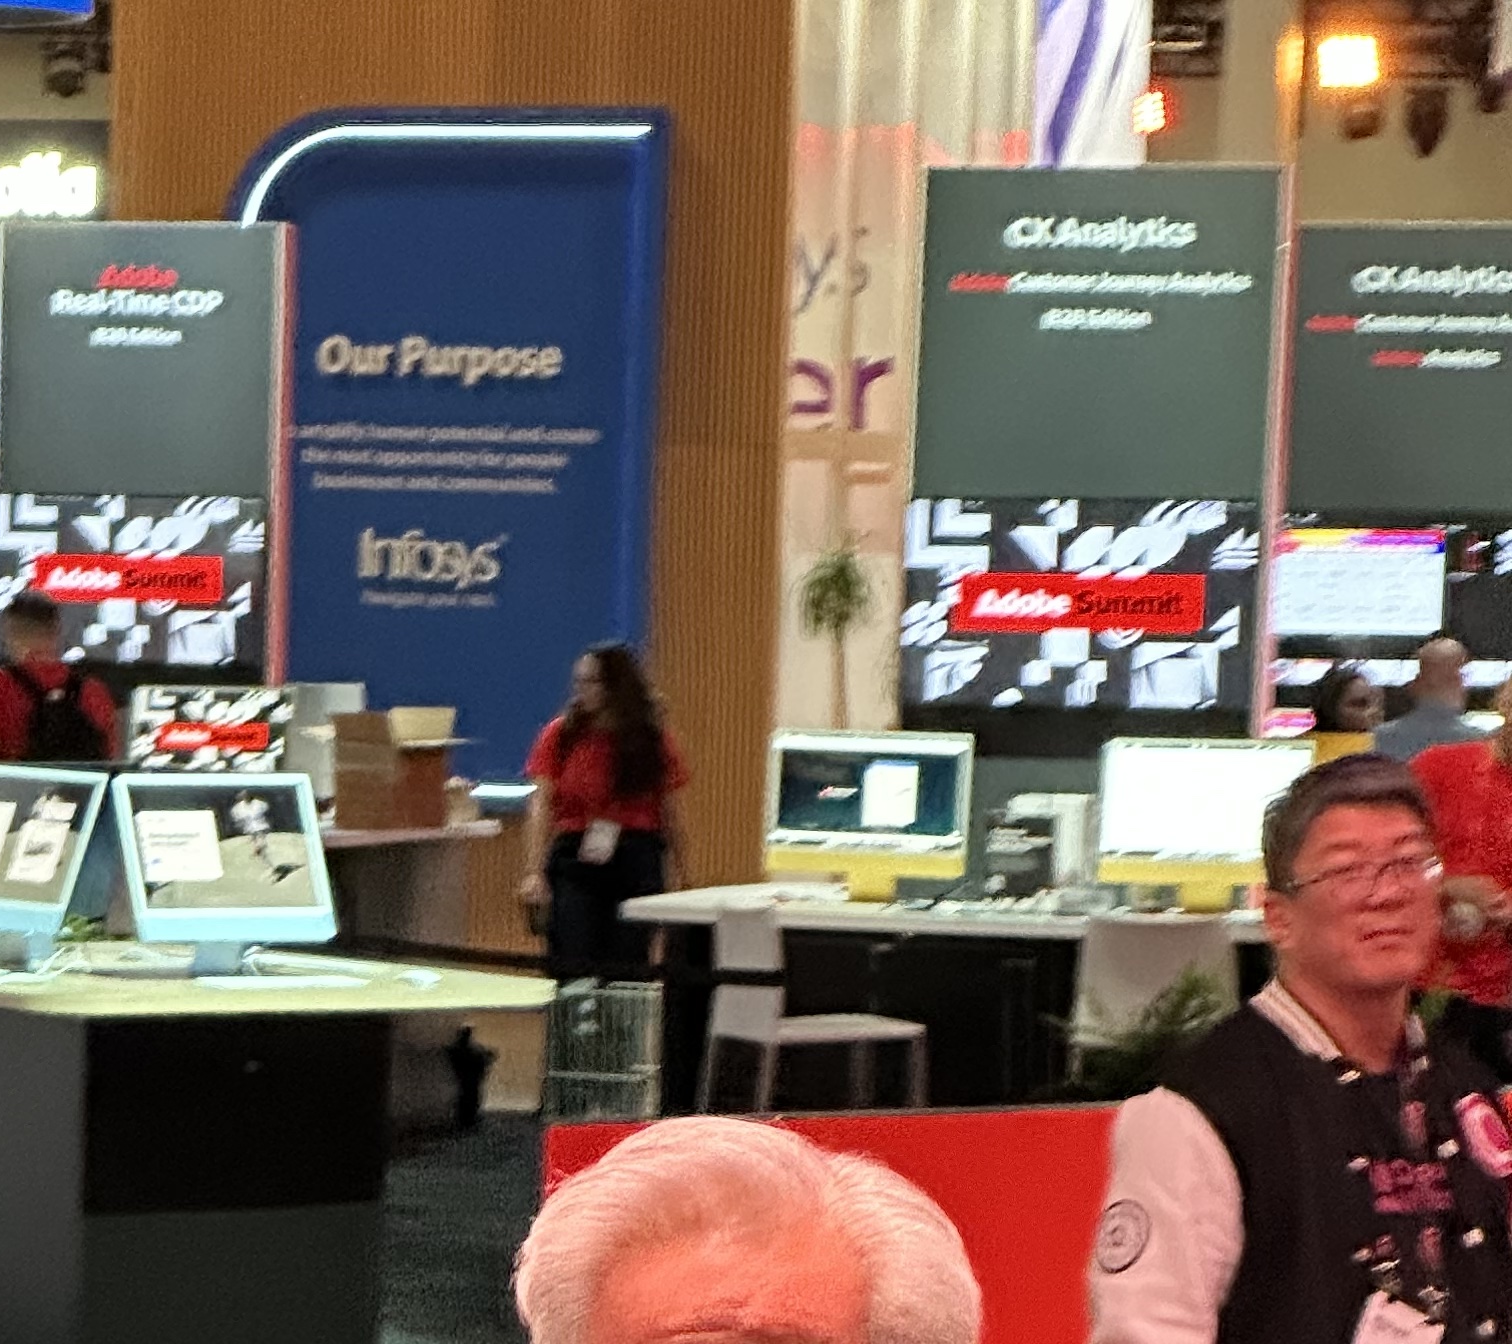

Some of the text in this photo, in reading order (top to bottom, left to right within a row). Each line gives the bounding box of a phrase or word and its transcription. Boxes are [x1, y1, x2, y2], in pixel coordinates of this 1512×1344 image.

[1051, 216, 1198, 252] Analytics
[1397, 265, 1512, 297] Analytic
[49, 288, 170, 317] Real-Time
[316, 333, 564, 386] Our Purpose
[357, 527, 503, 590] Infosys
[971, 587, 1184, 618] Adobe Summit
